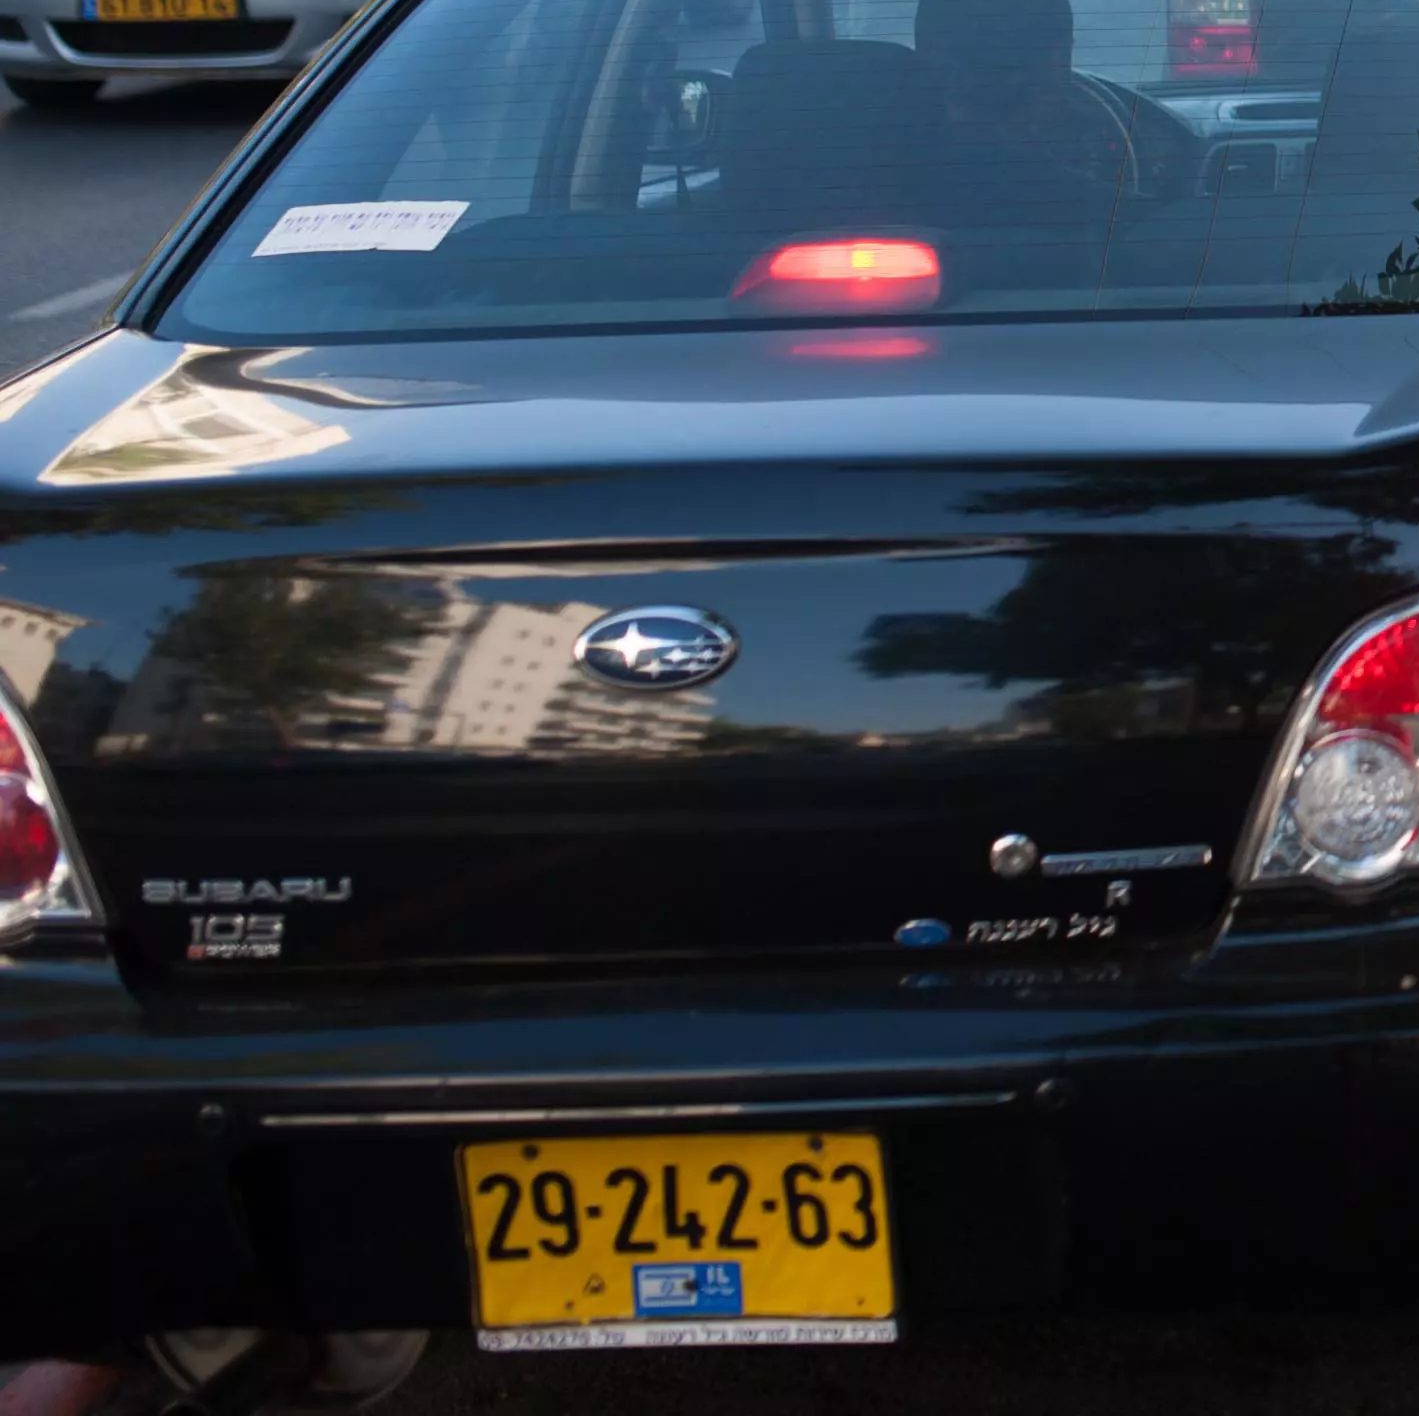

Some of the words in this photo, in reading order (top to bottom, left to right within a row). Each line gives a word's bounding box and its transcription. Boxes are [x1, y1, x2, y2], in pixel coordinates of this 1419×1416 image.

[141, 876, 352, 904] SUBARU
[188, 913, 286, 944] 105
[477, 1162, 878, 1262] 29-242-63
[706, 1265, 731, 1286] IL
